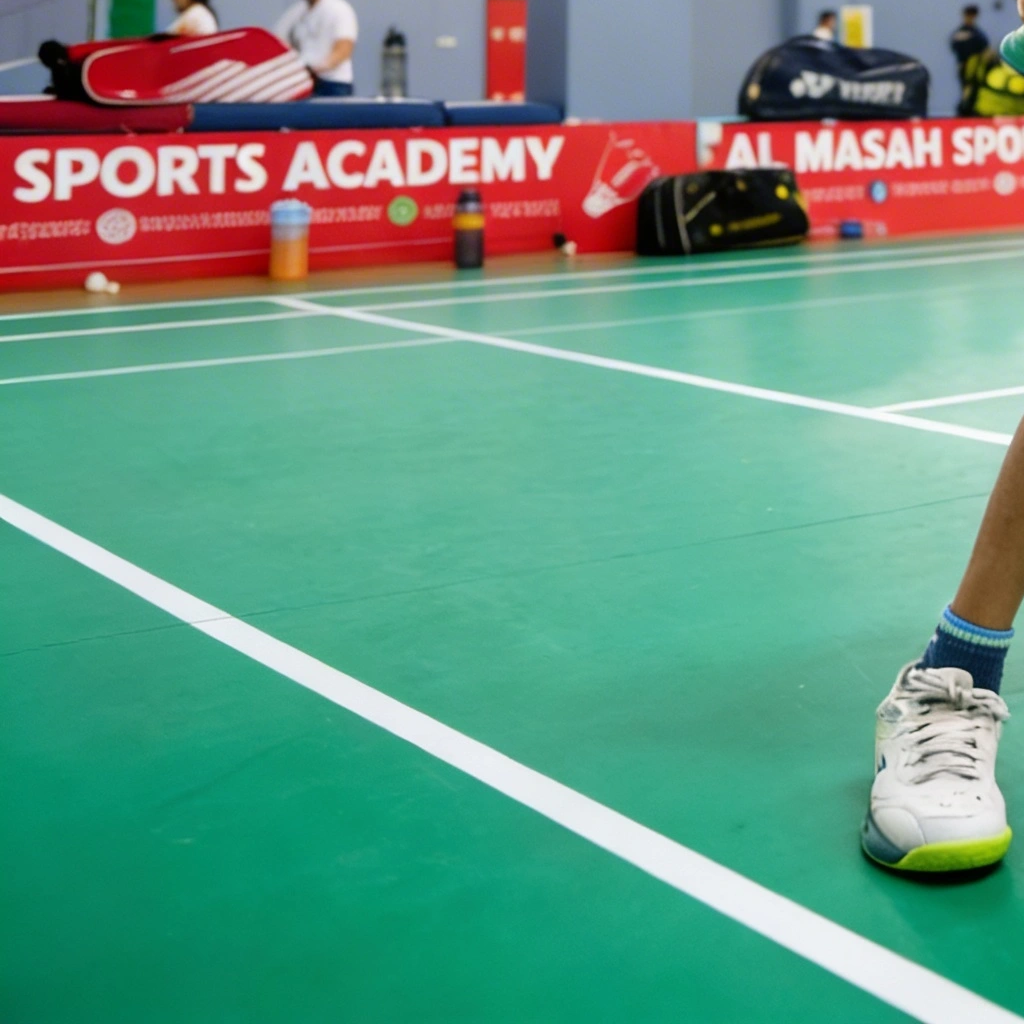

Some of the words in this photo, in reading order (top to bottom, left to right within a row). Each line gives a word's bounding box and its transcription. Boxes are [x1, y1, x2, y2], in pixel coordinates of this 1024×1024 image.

[13, 142, 268, 203] SPORTS
[282, 135, 565, 192] ACADEMY
[726, 132, 787, 171] AL
[794, 126, 943, 174] MASAH
